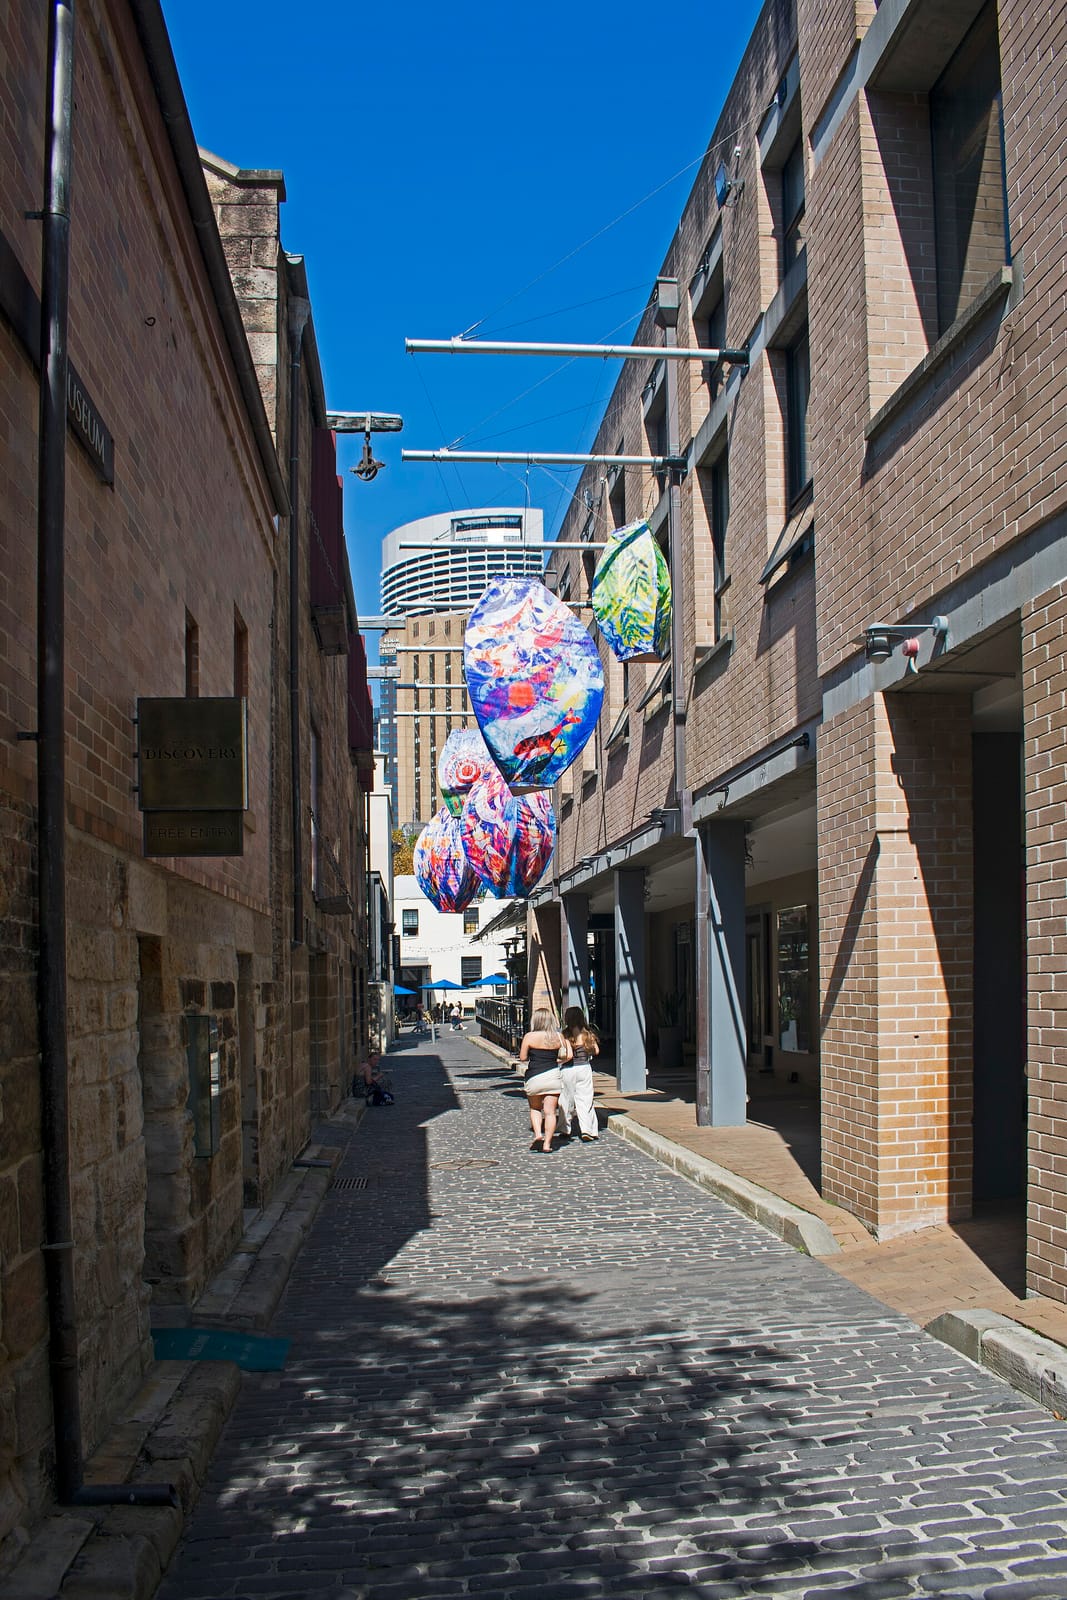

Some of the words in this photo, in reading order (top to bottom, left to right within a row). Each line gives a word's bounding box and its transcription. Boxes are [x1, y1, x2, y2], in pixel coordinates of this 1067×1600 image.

[68, 373, 105, 463] USEUM
[145, 748, 237, 760] DISCOVERY
[150, 827, 184, 839] FREE
[190, 825, 233, 838] ENTRY
